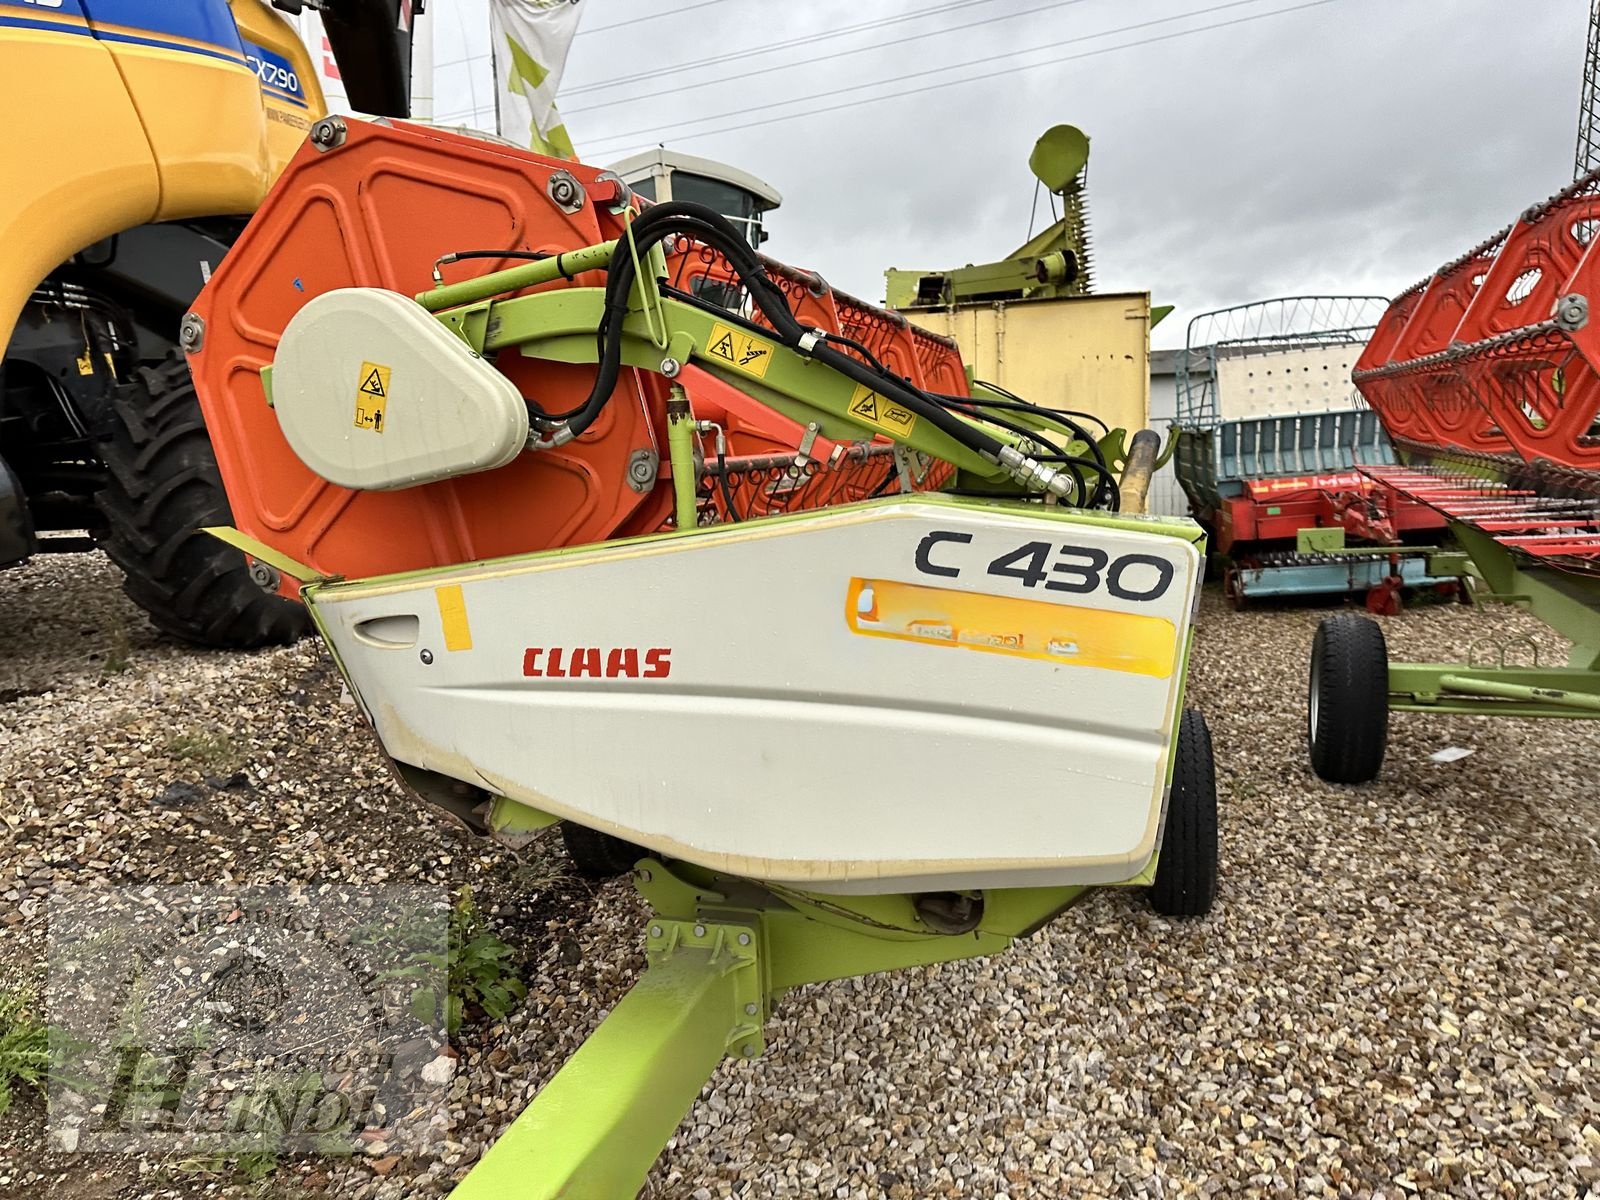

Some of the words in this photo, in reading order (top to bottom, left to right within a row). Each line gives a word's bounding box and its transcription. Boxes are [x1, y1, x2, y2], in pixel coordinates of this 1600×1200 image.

[915, 531, 974, 578] C
[987, 541, 1175, 602] 430
[523, 648, 672, 678] CLAAS
